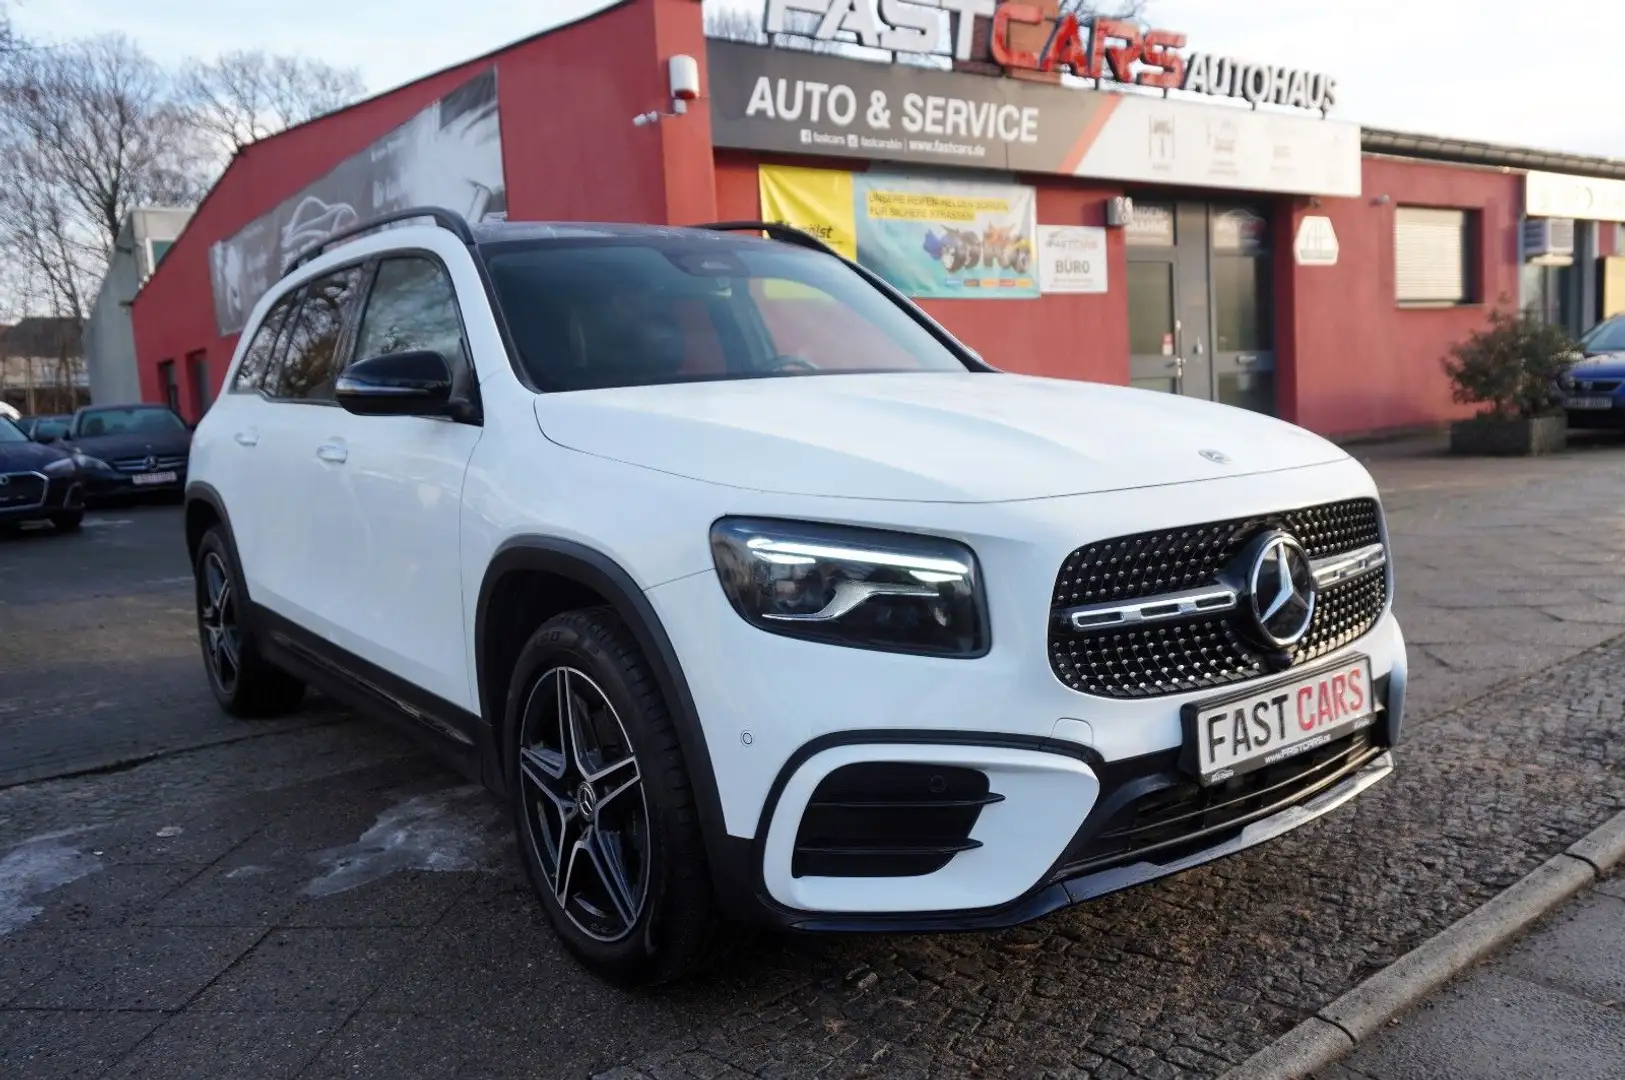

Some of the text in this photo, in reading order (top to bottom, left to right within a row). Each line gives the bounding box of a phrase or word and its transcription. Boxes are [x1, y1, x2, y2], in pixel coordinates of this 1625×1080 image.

[766, 0, 1187, 90] FAST CARS
[746, 76, 1040, 143] AUTO & SERVICE
[1184, 52, 1338, 108] AUTOHAUS
[1055, 255, 1090, 274] BÜRO
[1207, 667, 1365, 763] FAST CARS
